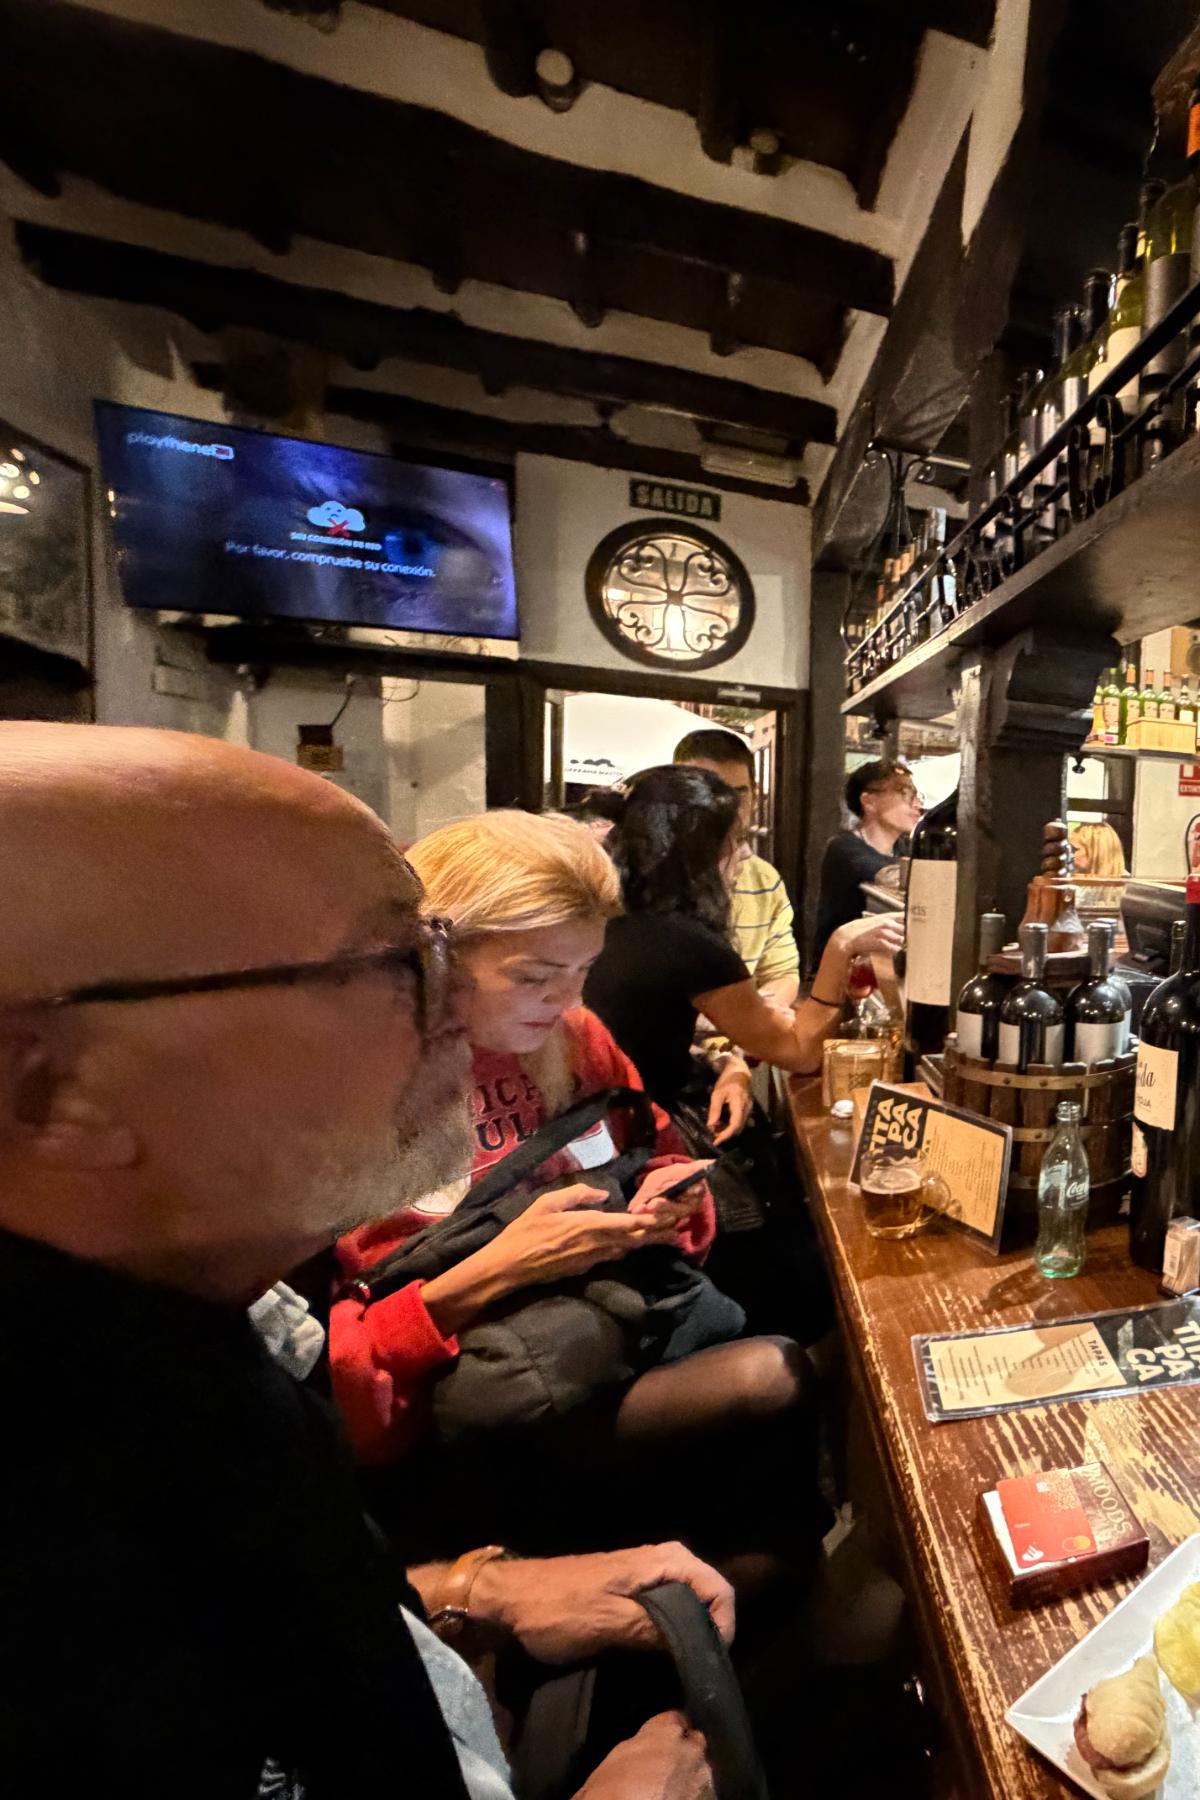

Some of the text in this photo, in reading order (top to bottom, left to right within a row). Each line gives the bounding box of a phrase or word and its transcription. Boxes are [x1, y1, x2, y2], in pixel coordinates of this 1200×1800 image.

[636, 484, 713, 516] SALIDA
[225, 540, 248, 553] Por
[365, 560, 380, 571] su
[887, 1103, 909, 1143] PA
[902, 1107, 923, 1150] CA
[1087, 1339, 1108, 1368] TAPAS
[1126, 1347, 1165, 1383] CA
[1153, 1343, 1195, 1378] PA
[1085, 1467, 1133, 1536] MOODS
